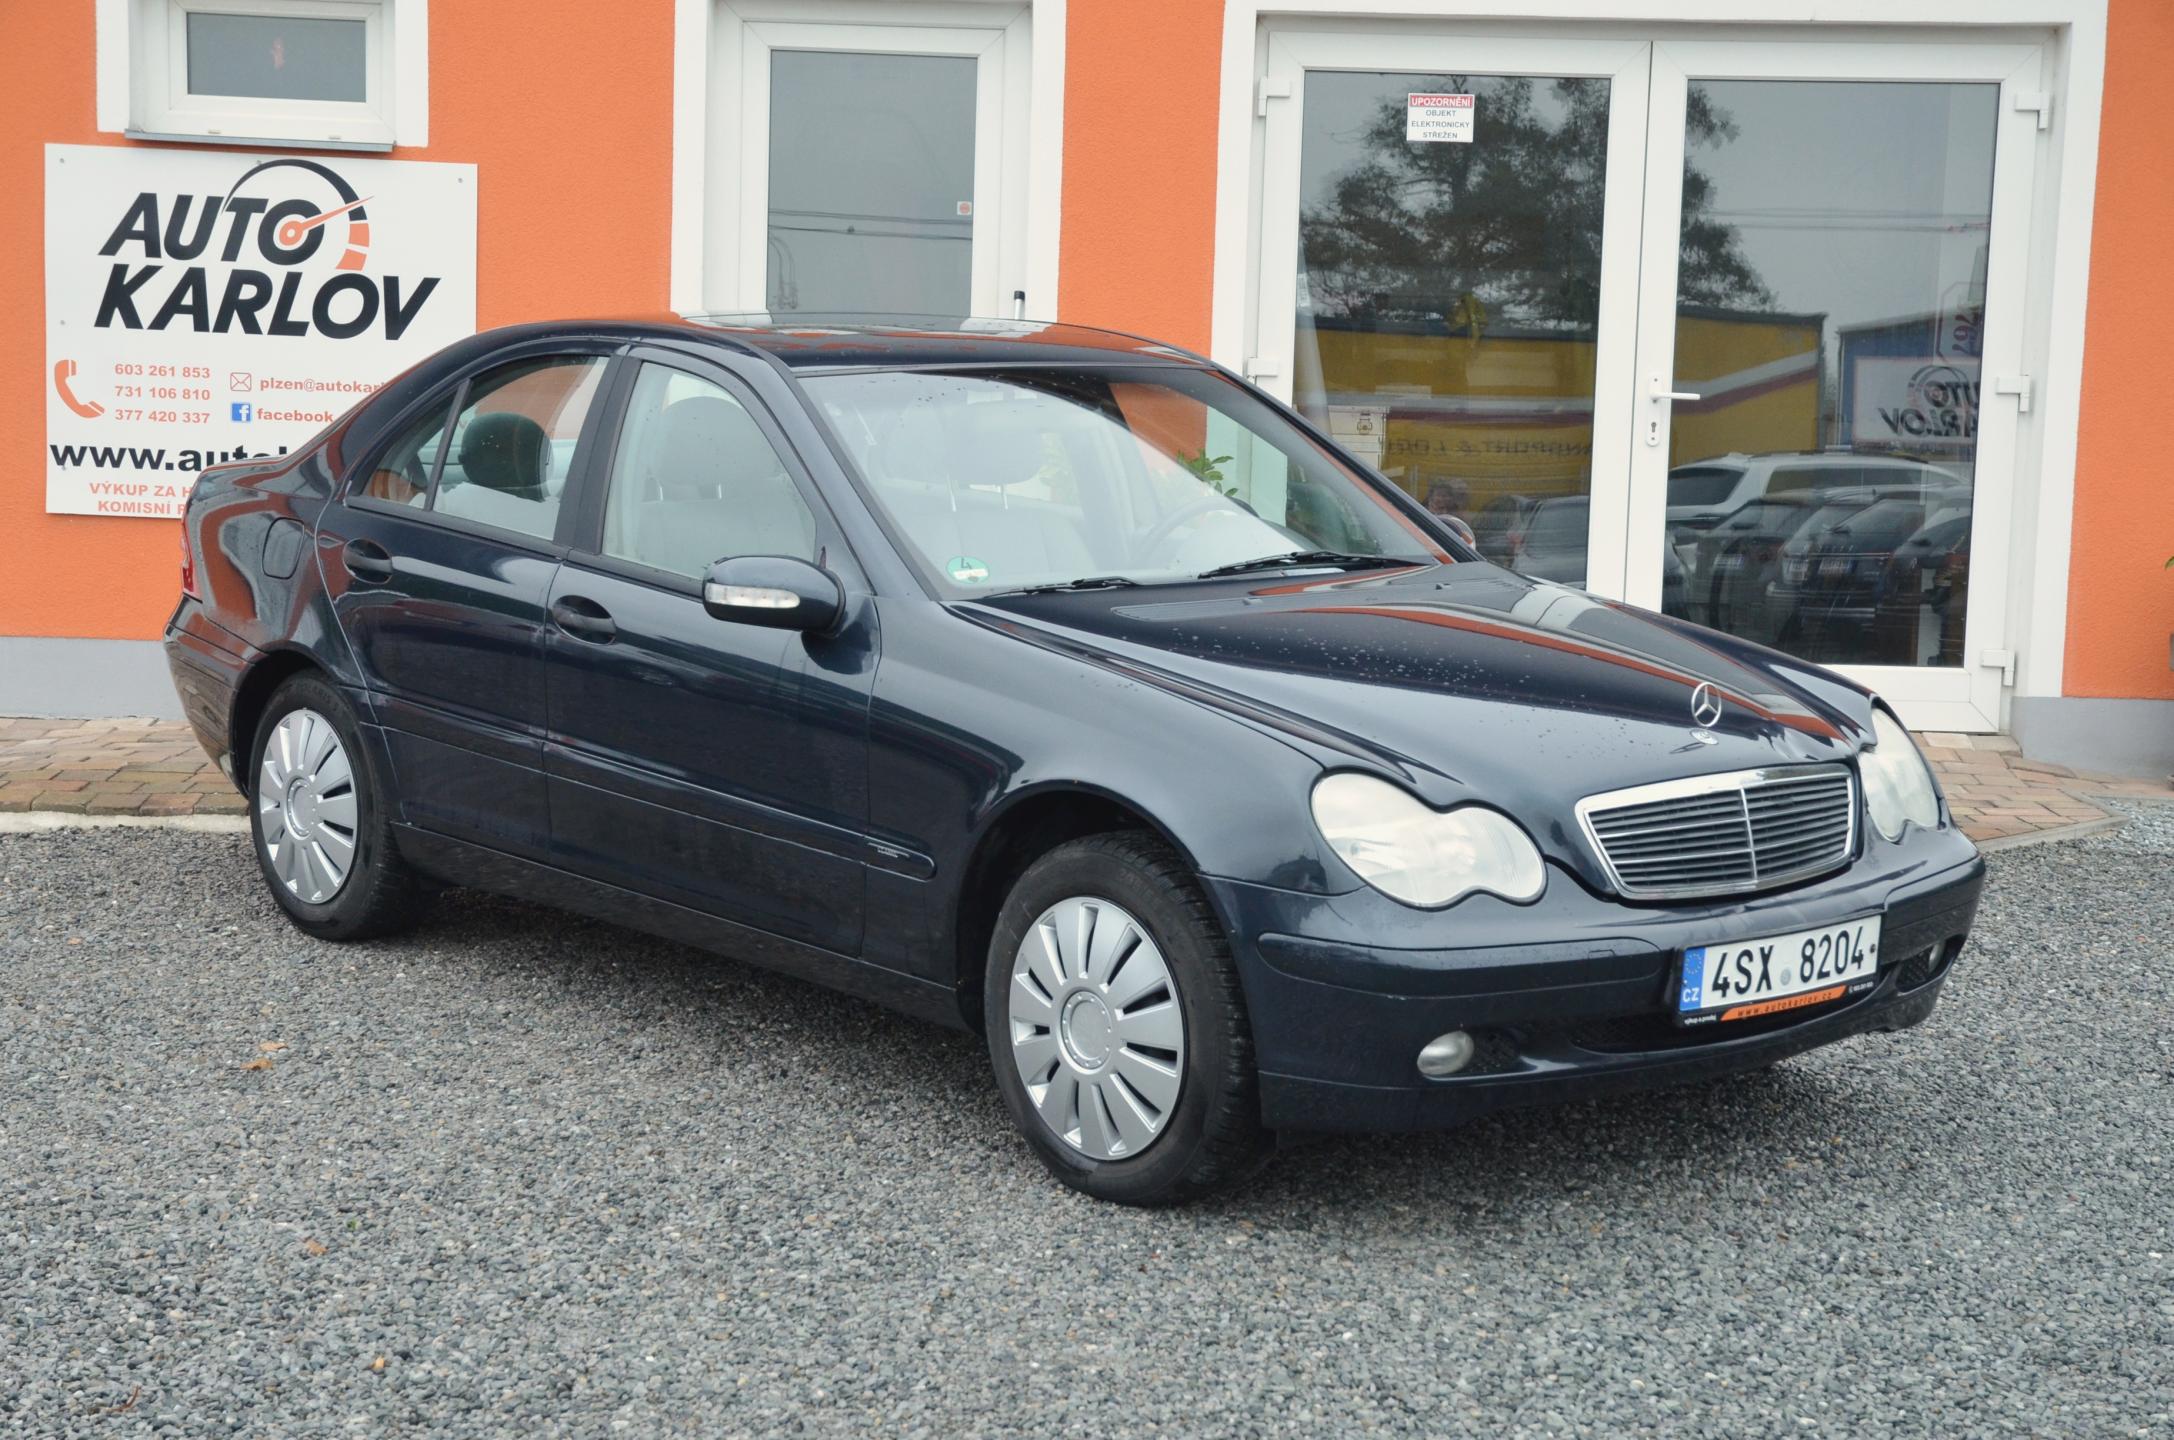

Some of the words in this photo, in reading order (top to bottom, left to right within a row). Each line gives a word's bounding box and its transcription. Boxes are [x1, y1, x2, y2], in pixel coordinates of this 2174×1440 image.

[1425, 109, 1457, 117] OBJEKT
[1411, 120, 1470, 128] ELEKTRONICKY
[1422, 131, 1458, 139] STŘEŽEN
[98, 192, 326, 266] AUTO
[94, 263, 441, 341] KARLOV
[115, 363, 143, 375] 603
[148, 365, 176, 377] 261
[182, 367, 210, 379] 853
[115, 386, 142, 397] 731
[149, 387, 177, 399] 106
[182, 388, 210, 400] 810
[115, 409, 143, 421] 377
[148, 411, 177, 422] 420
[182, 412, 210, 424] 337
[257, 408, 334, 423] facebook
[89, 481, 148, 497] VÝKUP
[153, 486, 176, 498] ZA
[98, 501, 171, 515] KOMISNÍ
[1712, 945, 1774, 998] 4SX
[1800, 926, 1864, 983] 8204
[1682, 986, 1700, 1003] CZ
